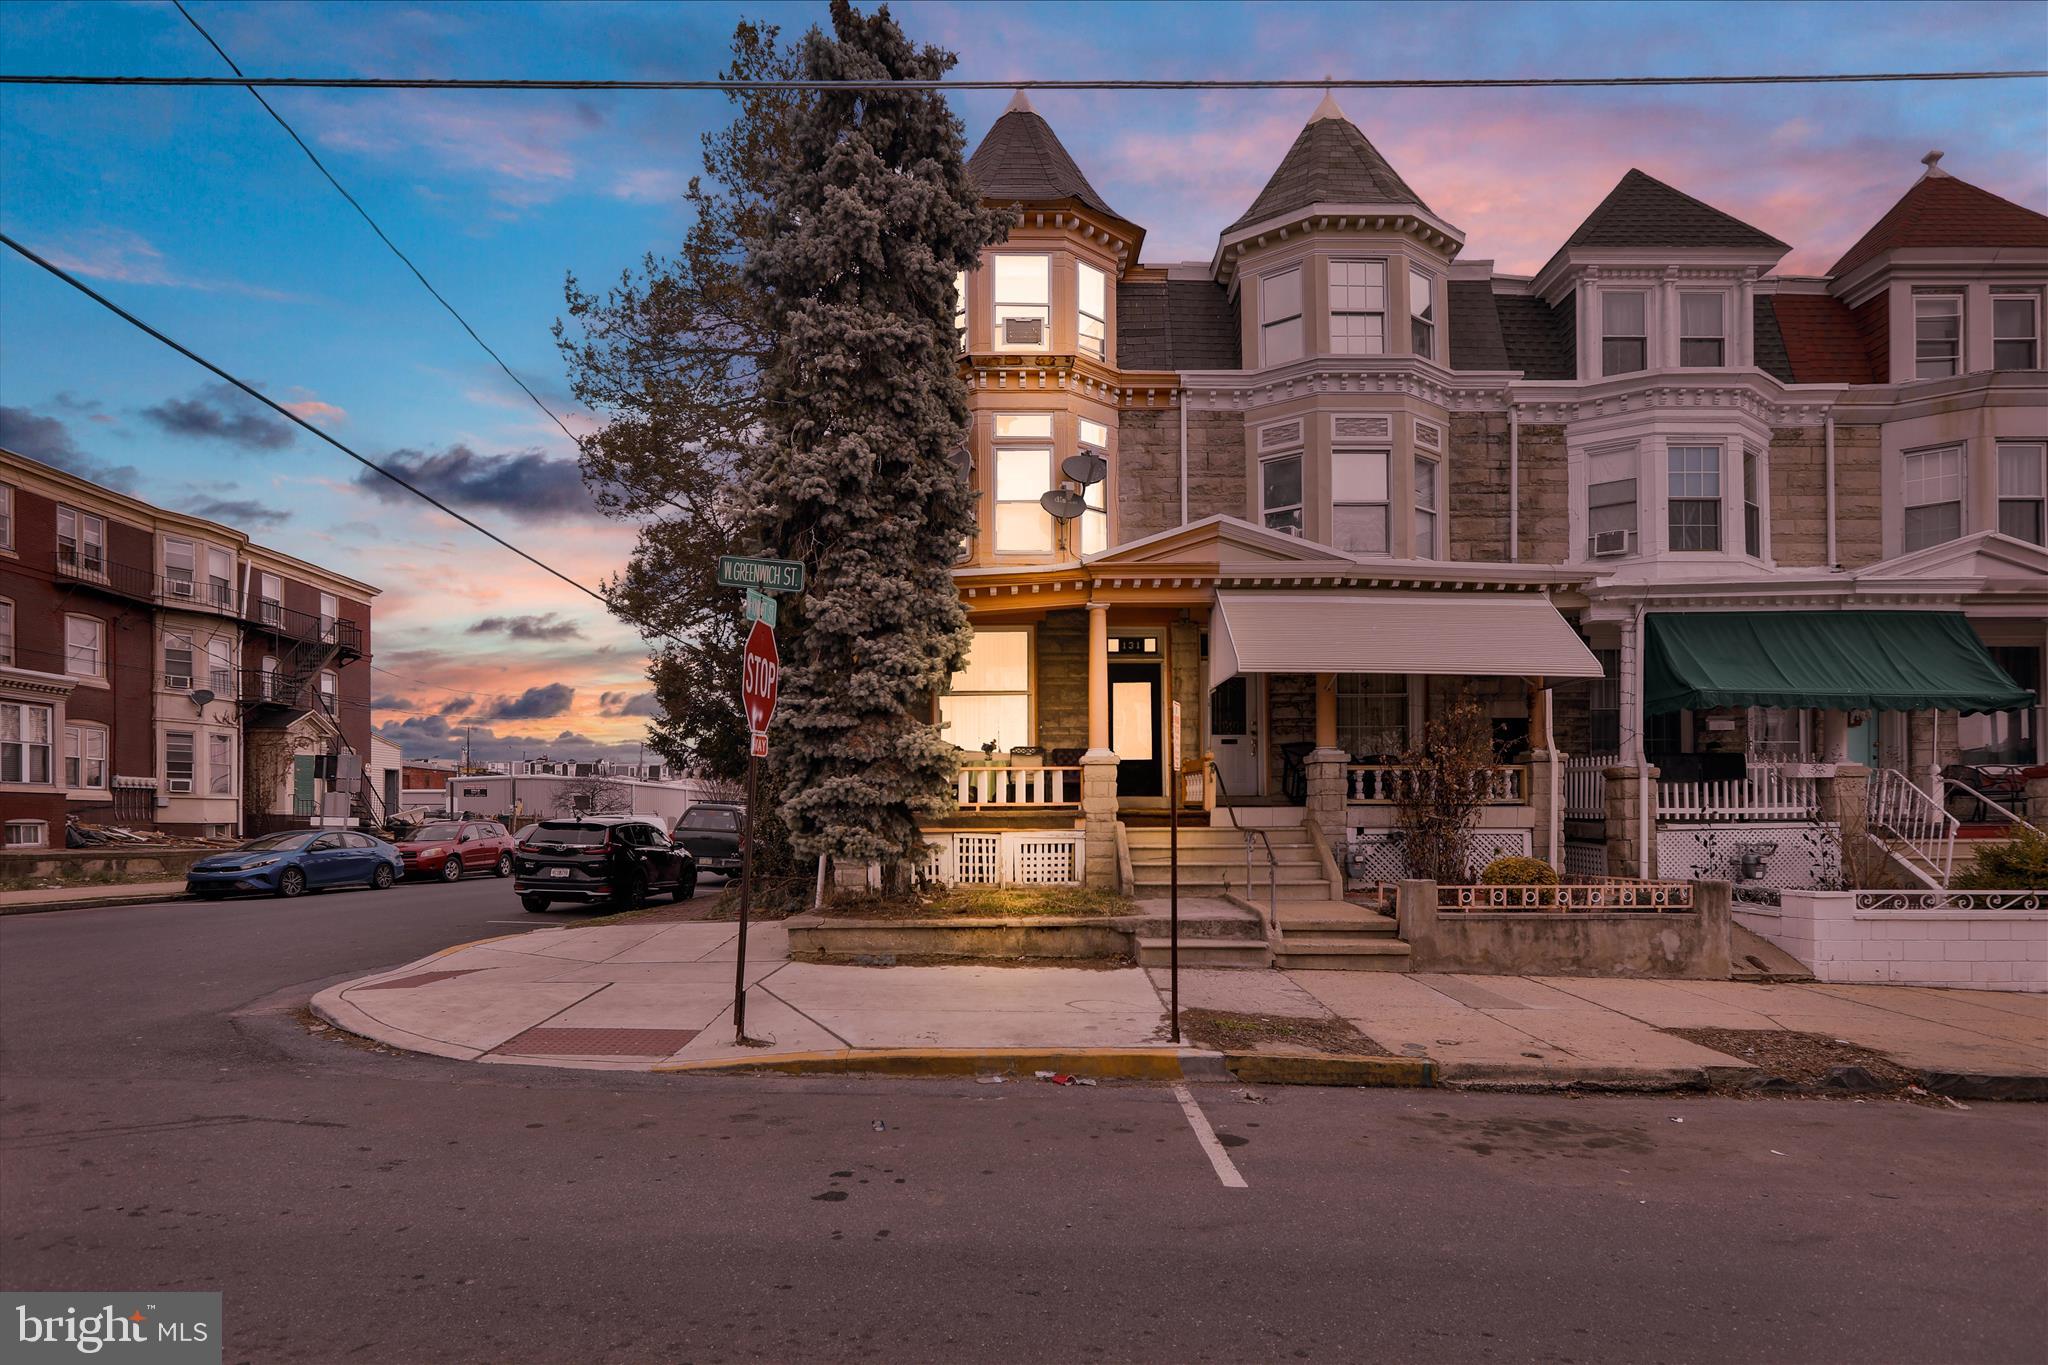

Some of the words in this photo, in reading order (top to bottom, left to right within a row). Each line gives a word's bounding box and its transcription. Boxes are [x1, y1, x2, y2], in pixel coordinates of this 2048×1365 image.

[733, 561, 781, 585] GREENWICH
[1122, 641, 1141, 650] 131
[745, 652, 776, 699] STOP
